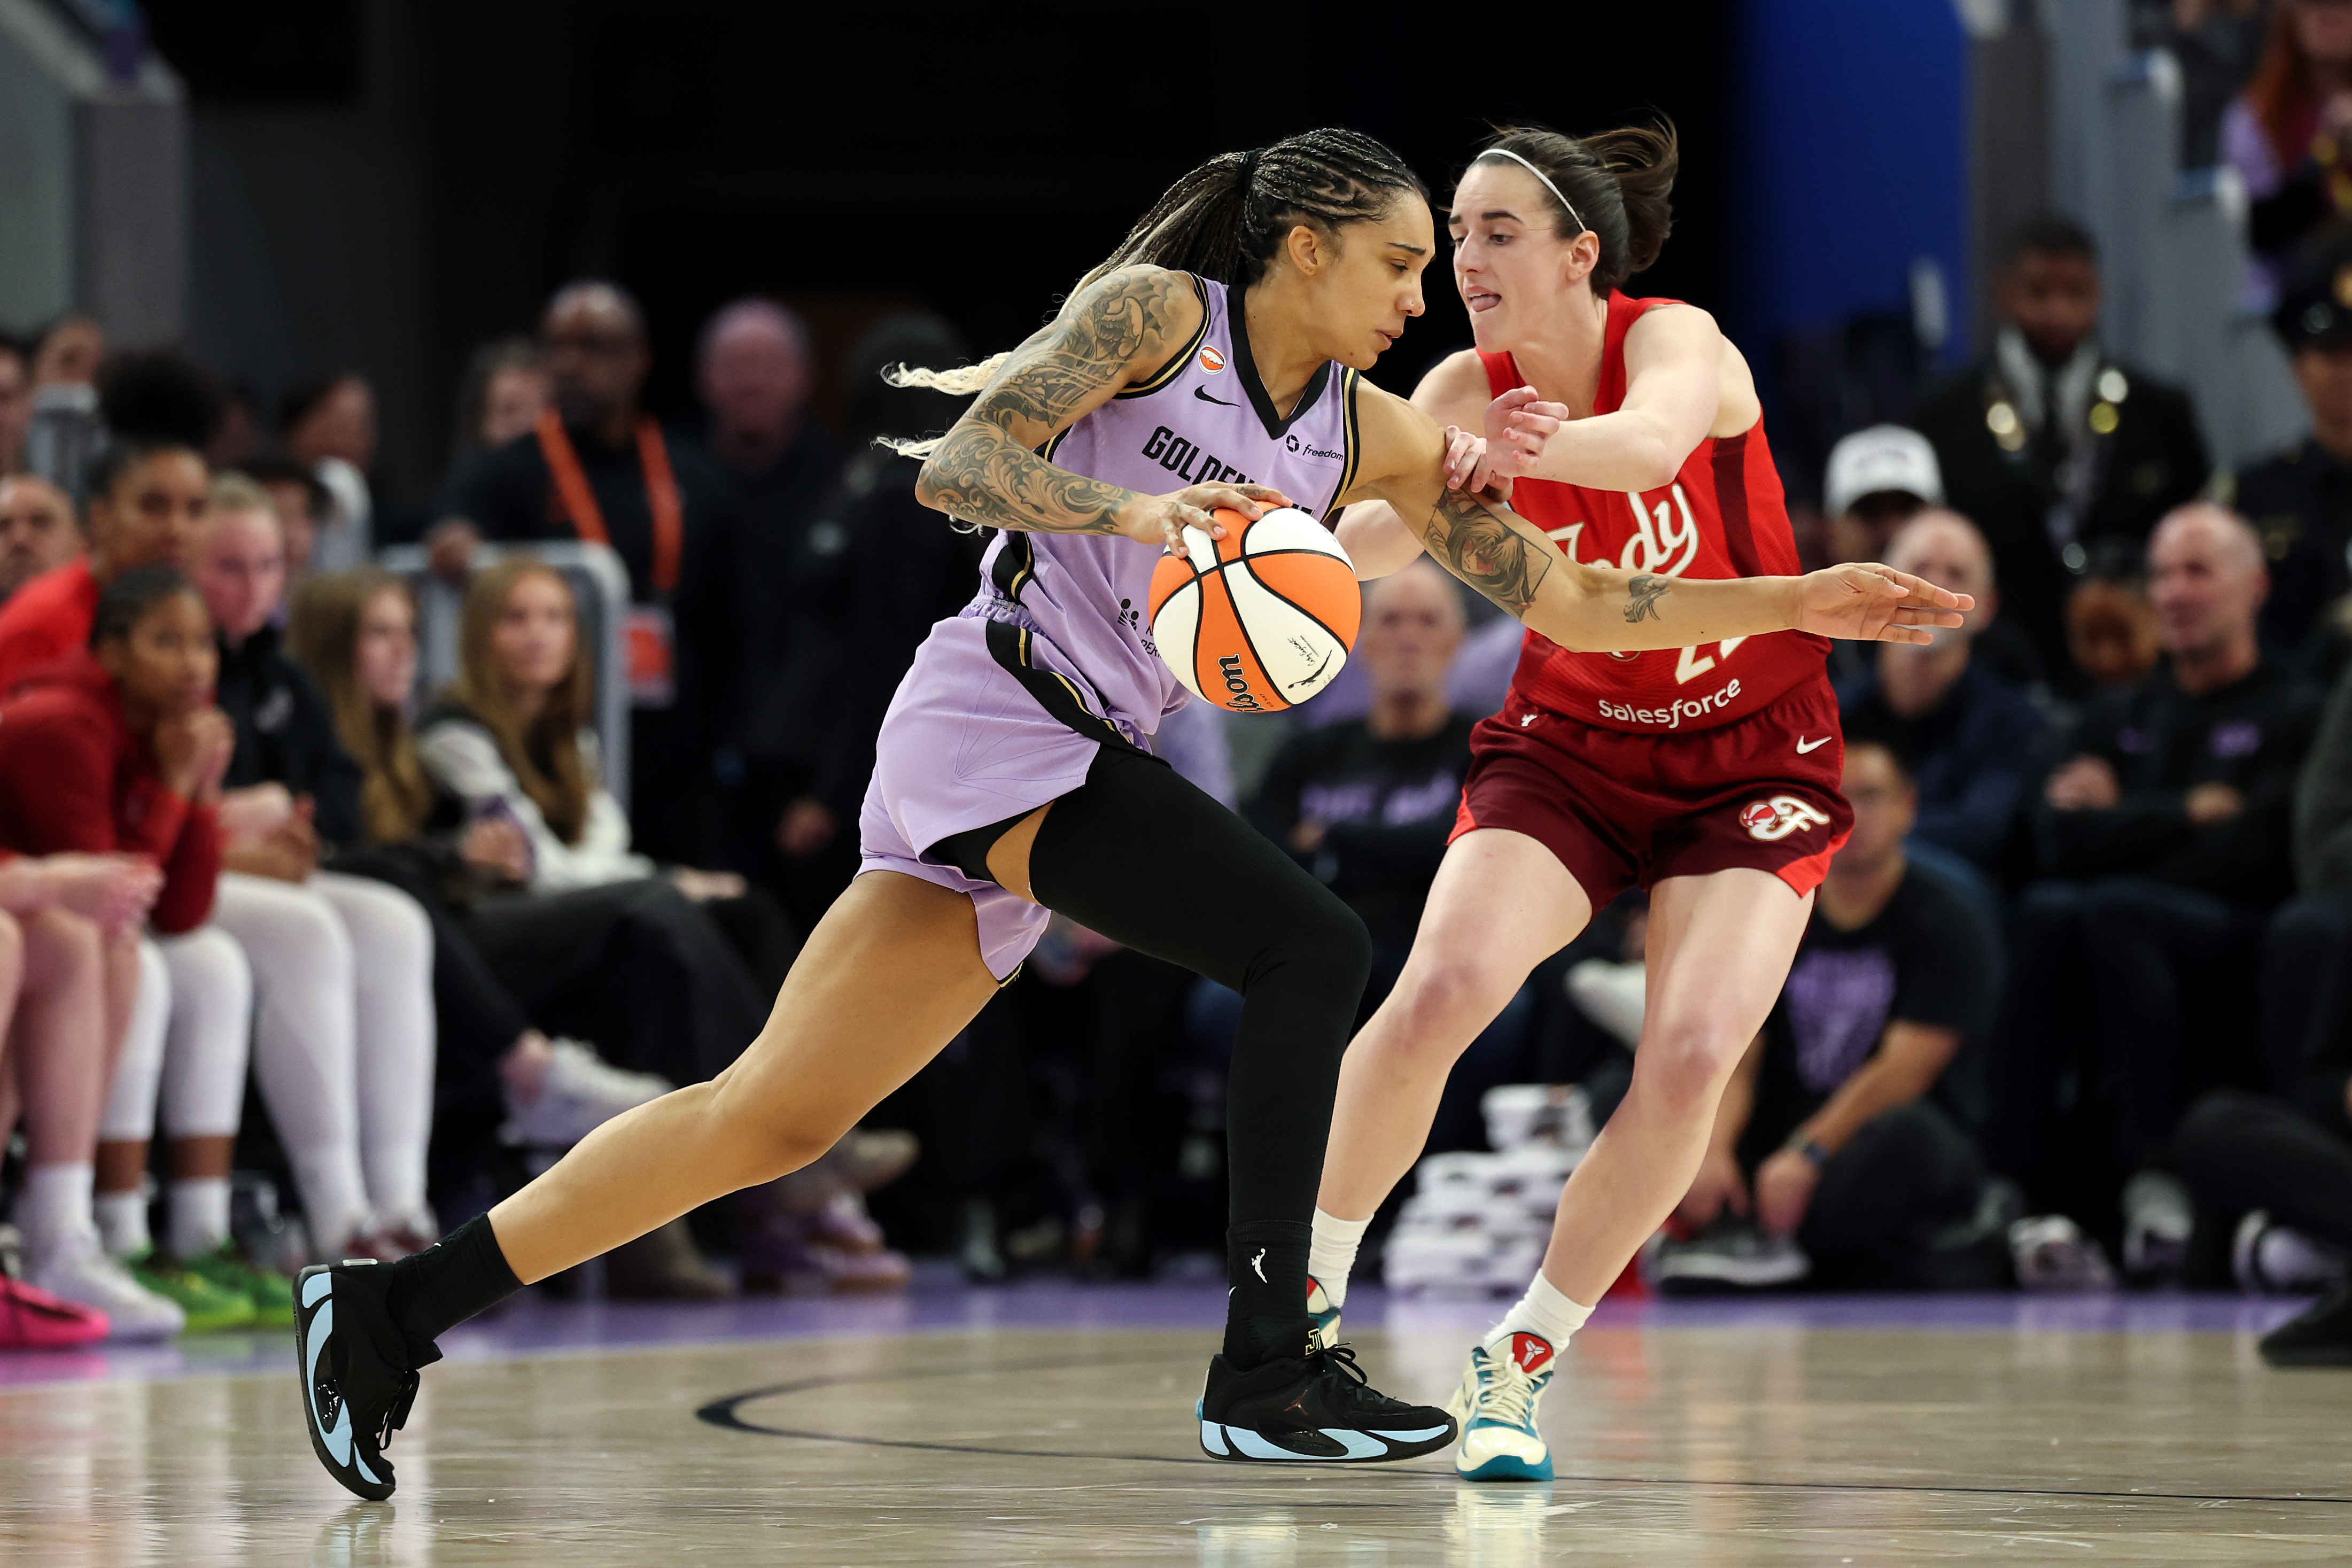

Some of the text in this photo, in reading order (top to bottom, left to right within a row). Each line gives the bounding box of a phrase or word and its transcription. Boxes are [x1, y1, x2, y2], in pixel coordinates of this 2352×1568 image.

[1302, 444, 1344, 462] freedom
[1546, 483, 1699, 578] dy
[1218, 653, 1266, 712] lson
